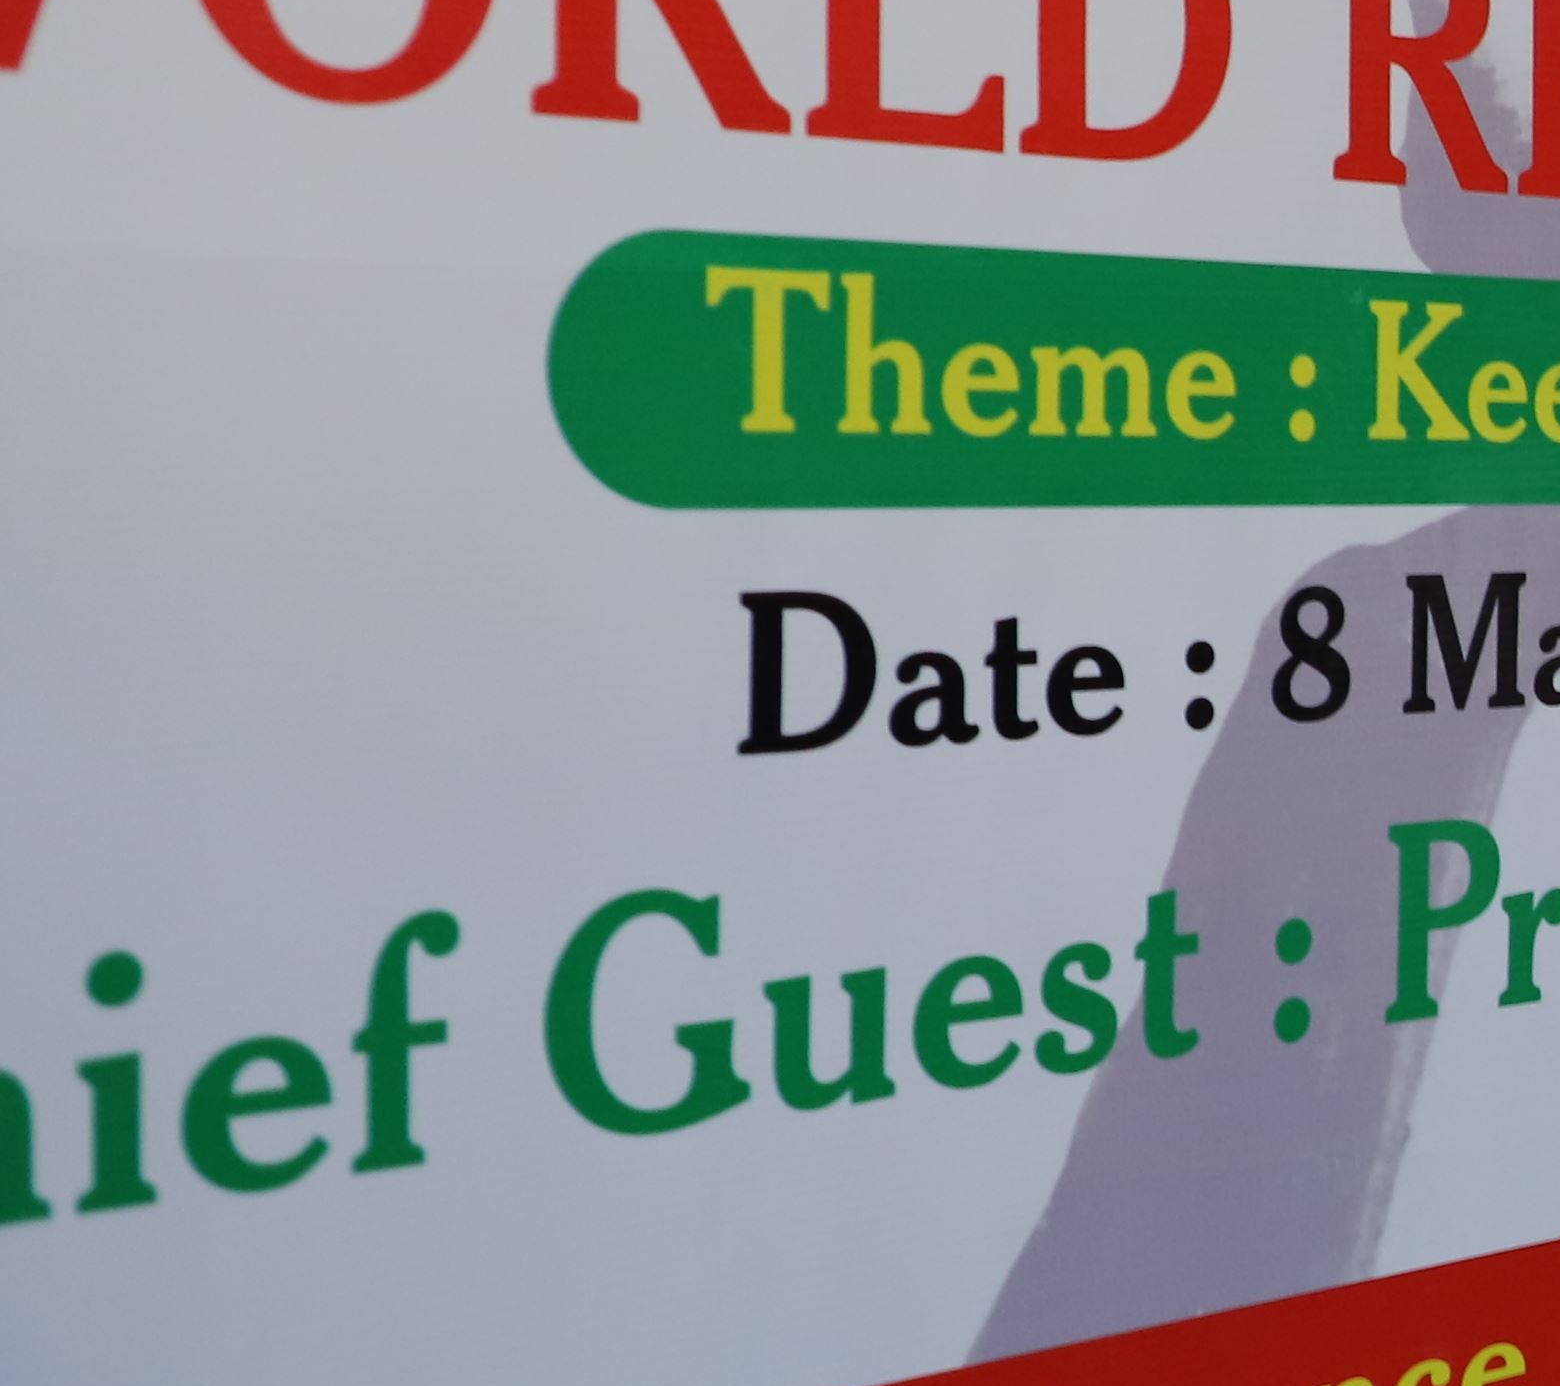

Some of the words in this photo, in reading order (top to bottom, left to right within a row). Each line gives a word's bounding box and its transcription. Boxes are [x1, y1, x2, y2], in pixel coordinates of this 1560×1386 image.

[704, 264, 1237, 440] Theme
[735, 589, 1126, 758] Date
[1270, 585, 1352, 724] 8
[544, 886, 1202, 1139] Guest
